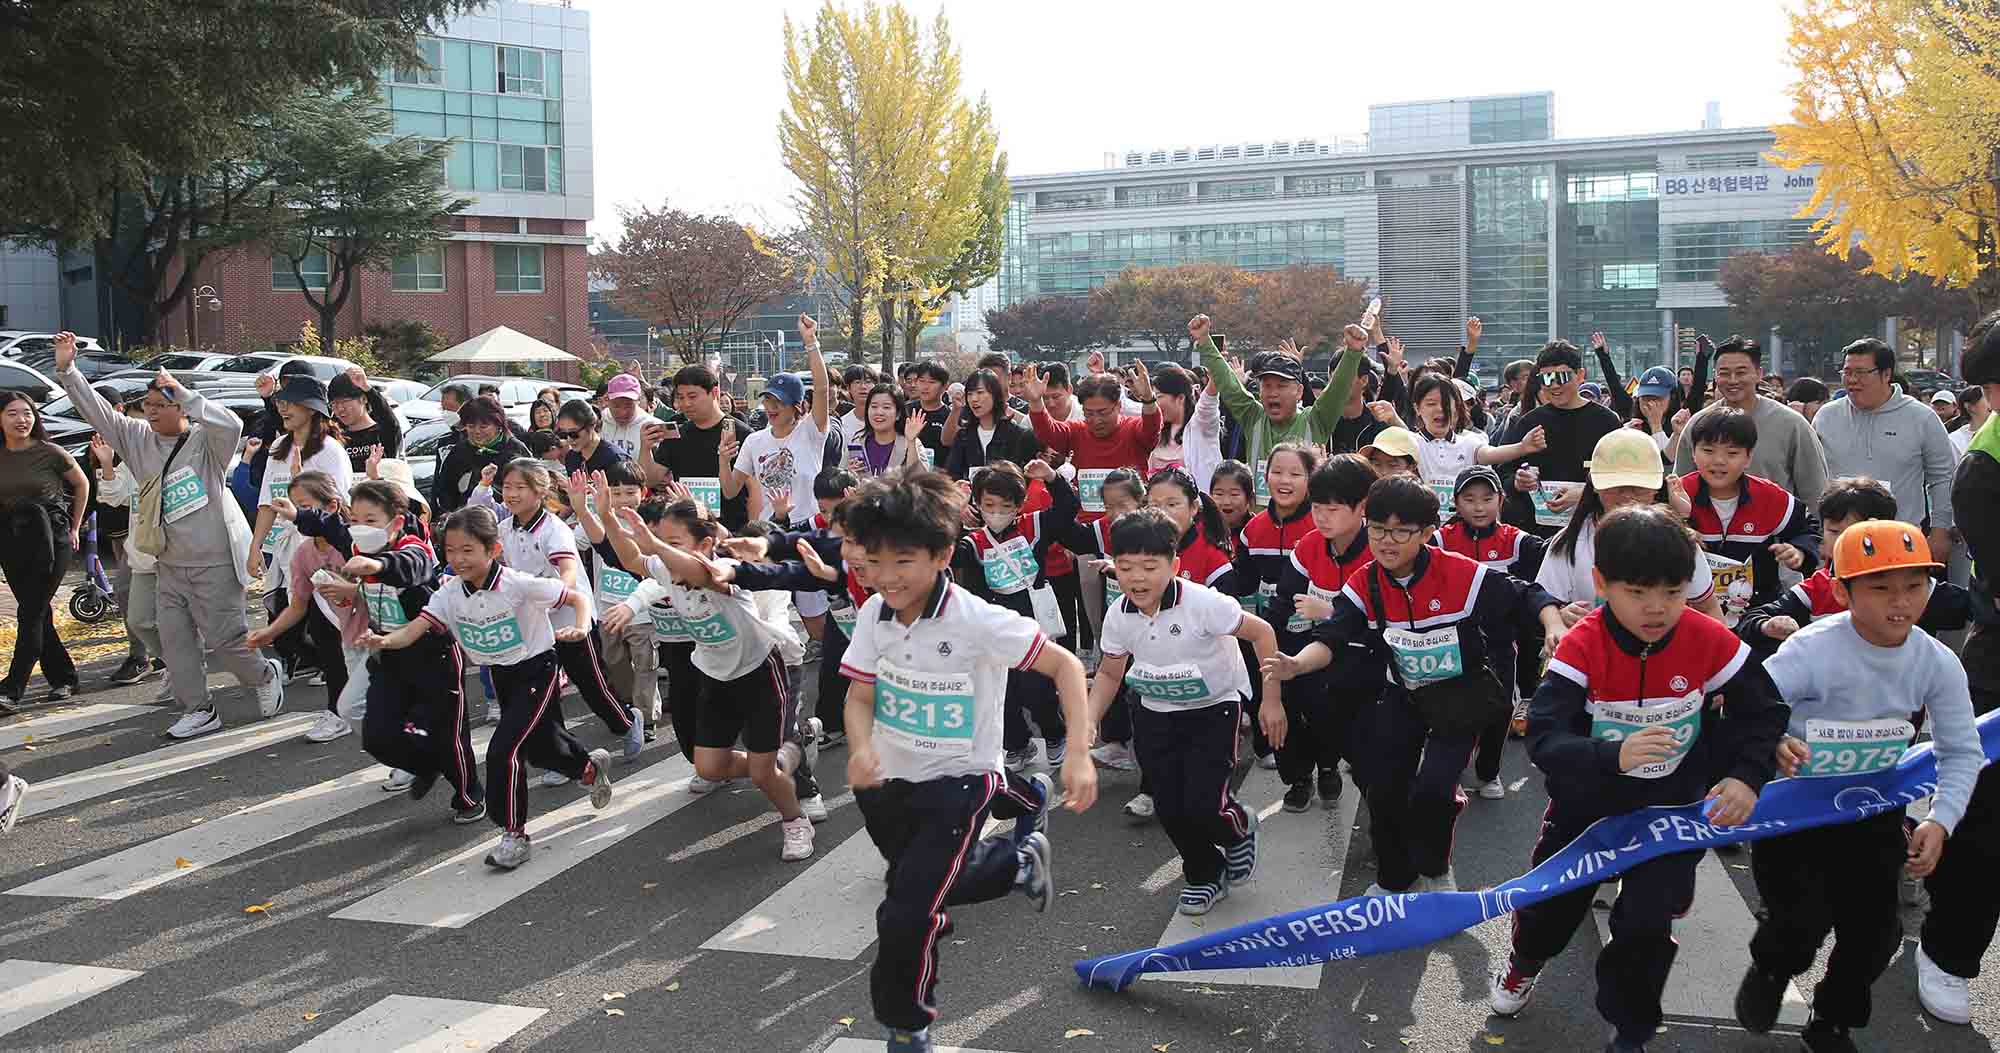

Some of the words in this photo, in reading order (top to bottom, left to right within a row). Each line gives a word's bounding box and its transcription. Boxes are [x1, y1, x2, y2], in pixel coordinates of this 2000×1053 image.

[1665, 178, 1688, 194] B8
[1691, 174, 1768, 193] 산학협력관
[1784, 175, 1813, 188] John
[992, 554, 1031, 582] 325
[463, 625, 514, 648] 3258
[1135, 682, 1200, 696] 3055
[882, 690, 964, 728] 3213
[914, 739, 937, 749] DCU
[1643, 764, 1666, 774] DCU
[1811, 746, 1899, 773] 2975
